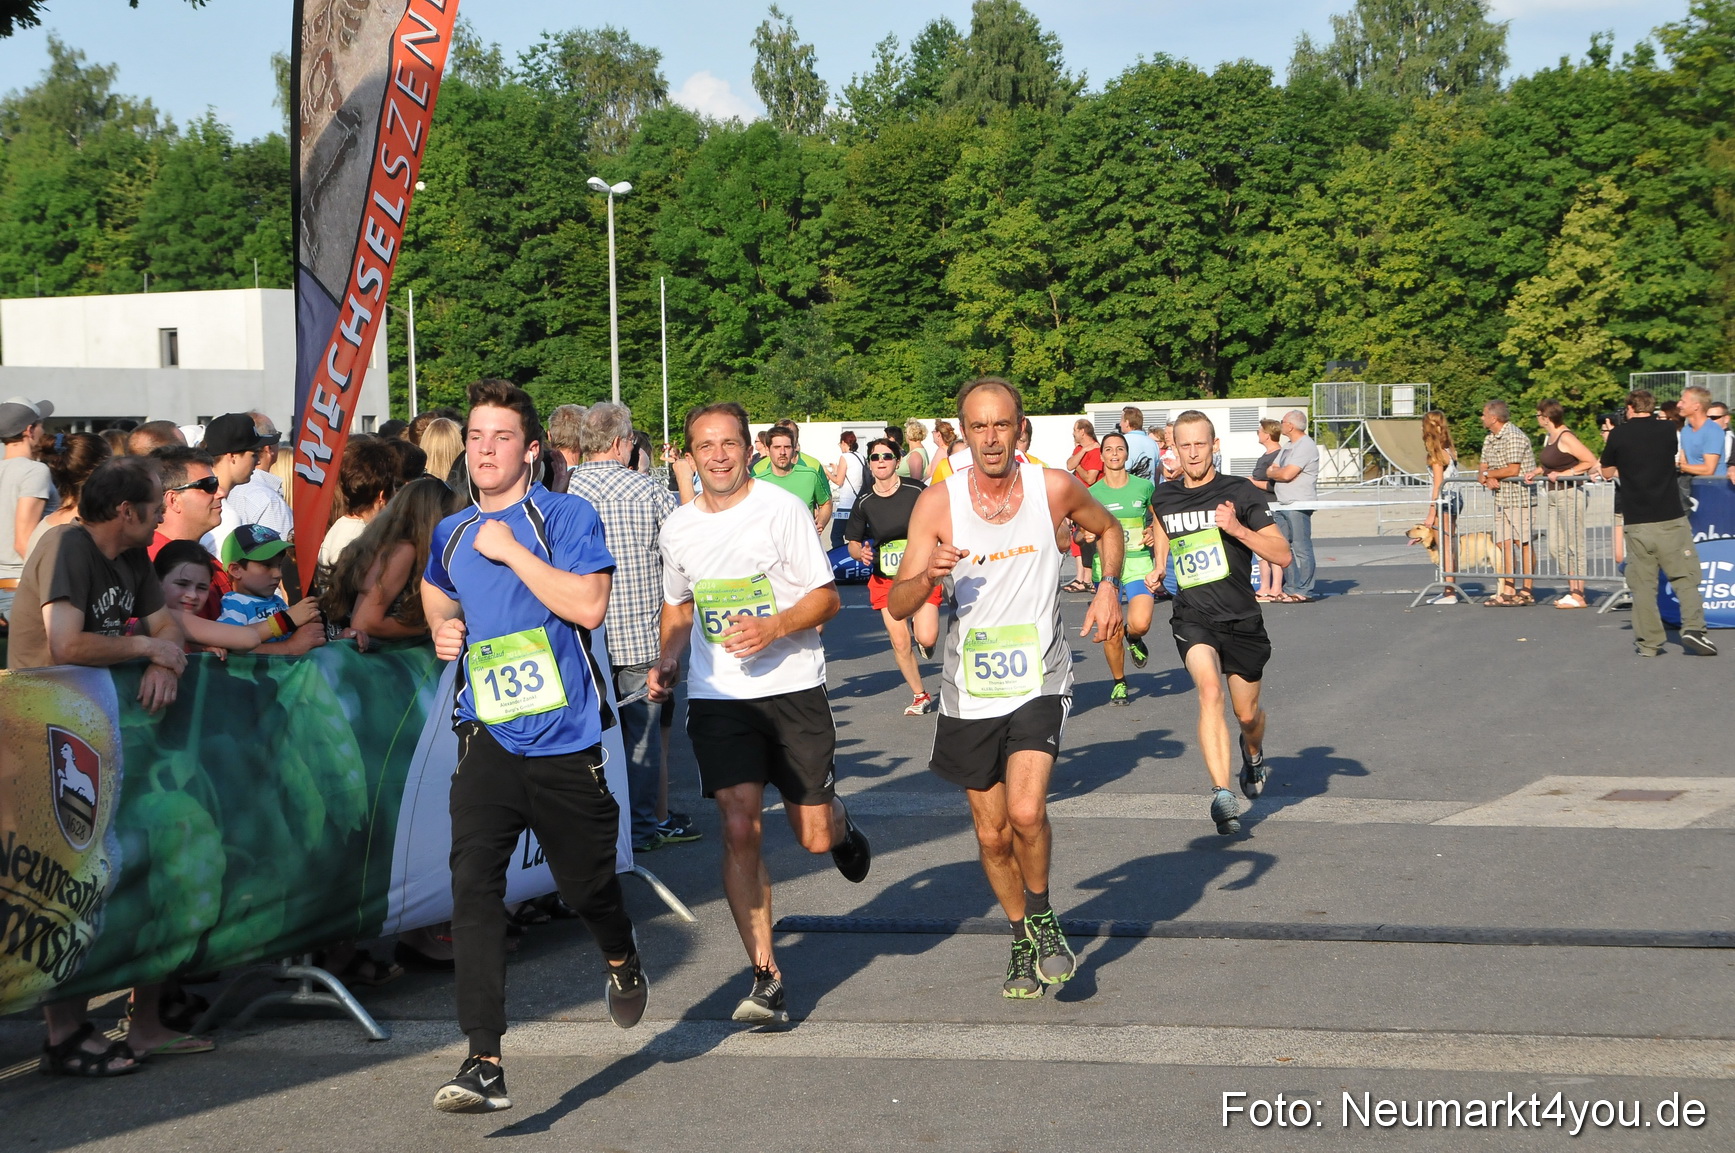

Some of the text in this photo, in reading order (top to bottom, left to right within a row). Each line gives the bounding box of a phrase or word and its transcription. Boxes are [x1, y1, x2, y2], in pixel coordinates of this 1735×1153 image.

[294, 0, 446, 486] WECHSELSZEN
[989, 545, 1039, 562] KLEBL
[1176, 546, 1221, 576] 1391
[845, 567, 874, 579] Fis
[975, 650, 1028, 680] 530
[484, 660, 545, 702] 133
[66, 813, 87, 841] 1628
[522, 828, 546, 870] La
